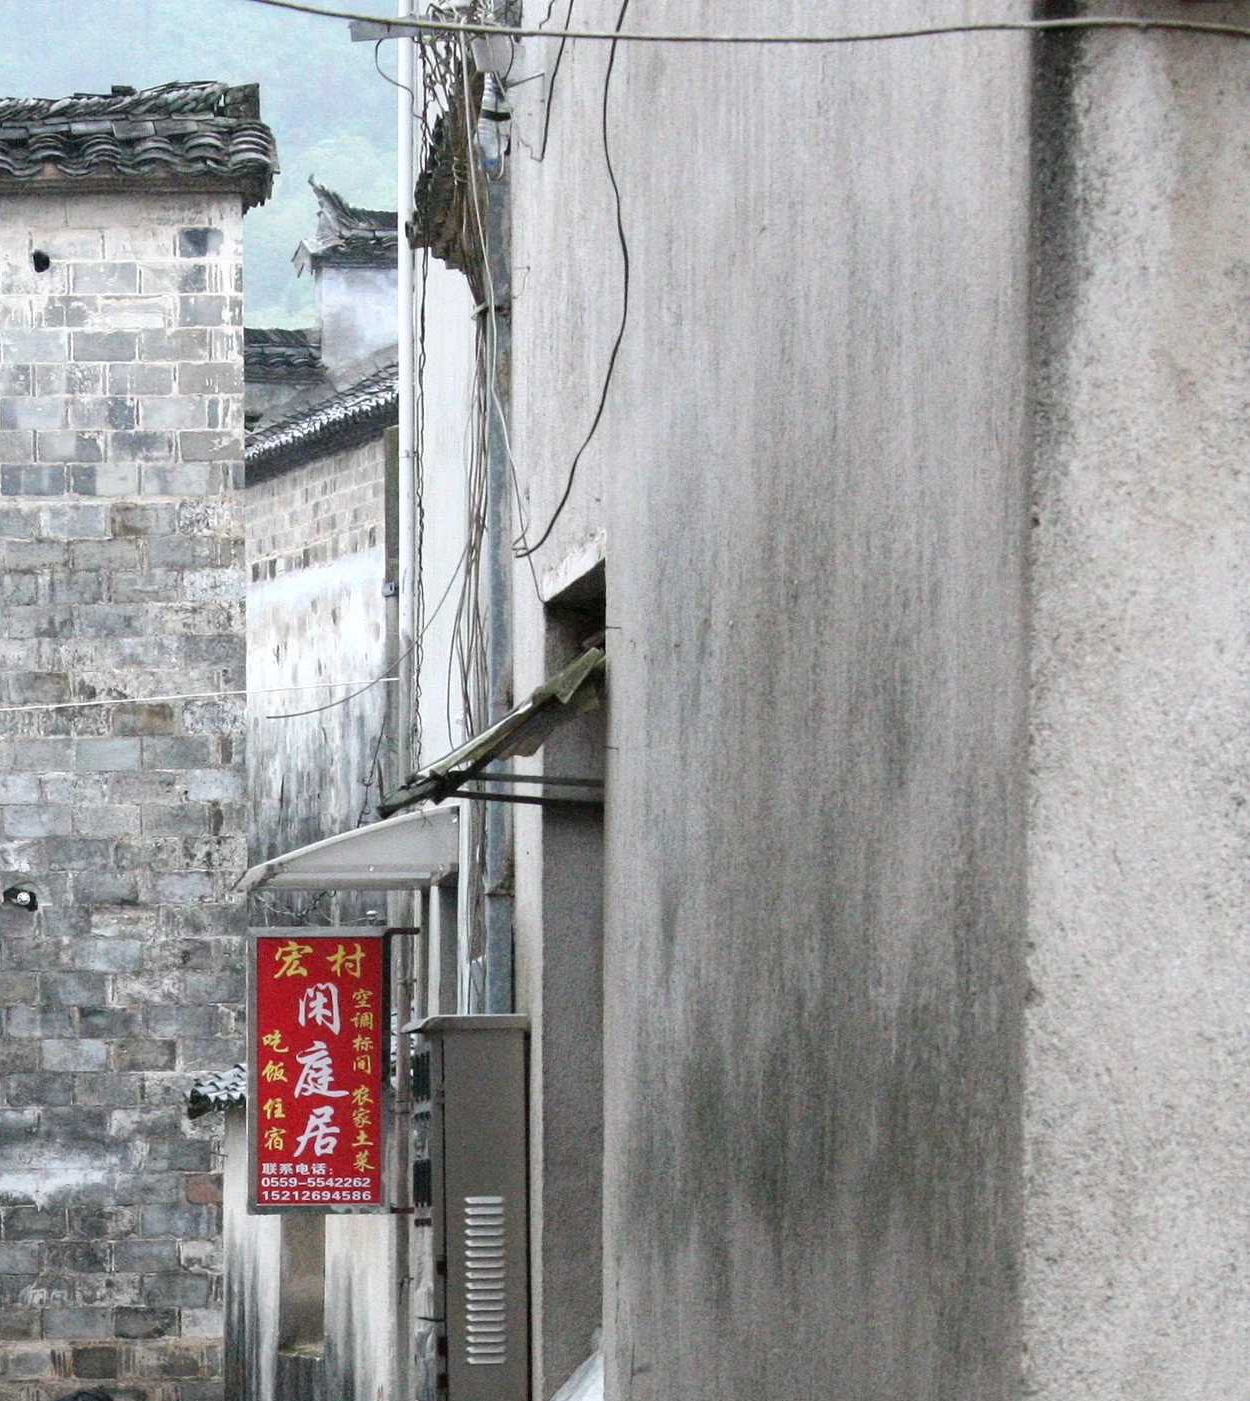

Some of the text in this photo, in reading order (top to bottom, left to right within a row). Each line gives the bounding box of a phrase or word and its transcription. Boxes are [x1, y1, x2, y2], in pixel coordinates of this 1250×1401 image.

[273, 940, 366, 979] 宏村
[350, 988, 376, 1173] 空调标间 农家土菜
[262, 1190, 372, 1201] 15212694586
